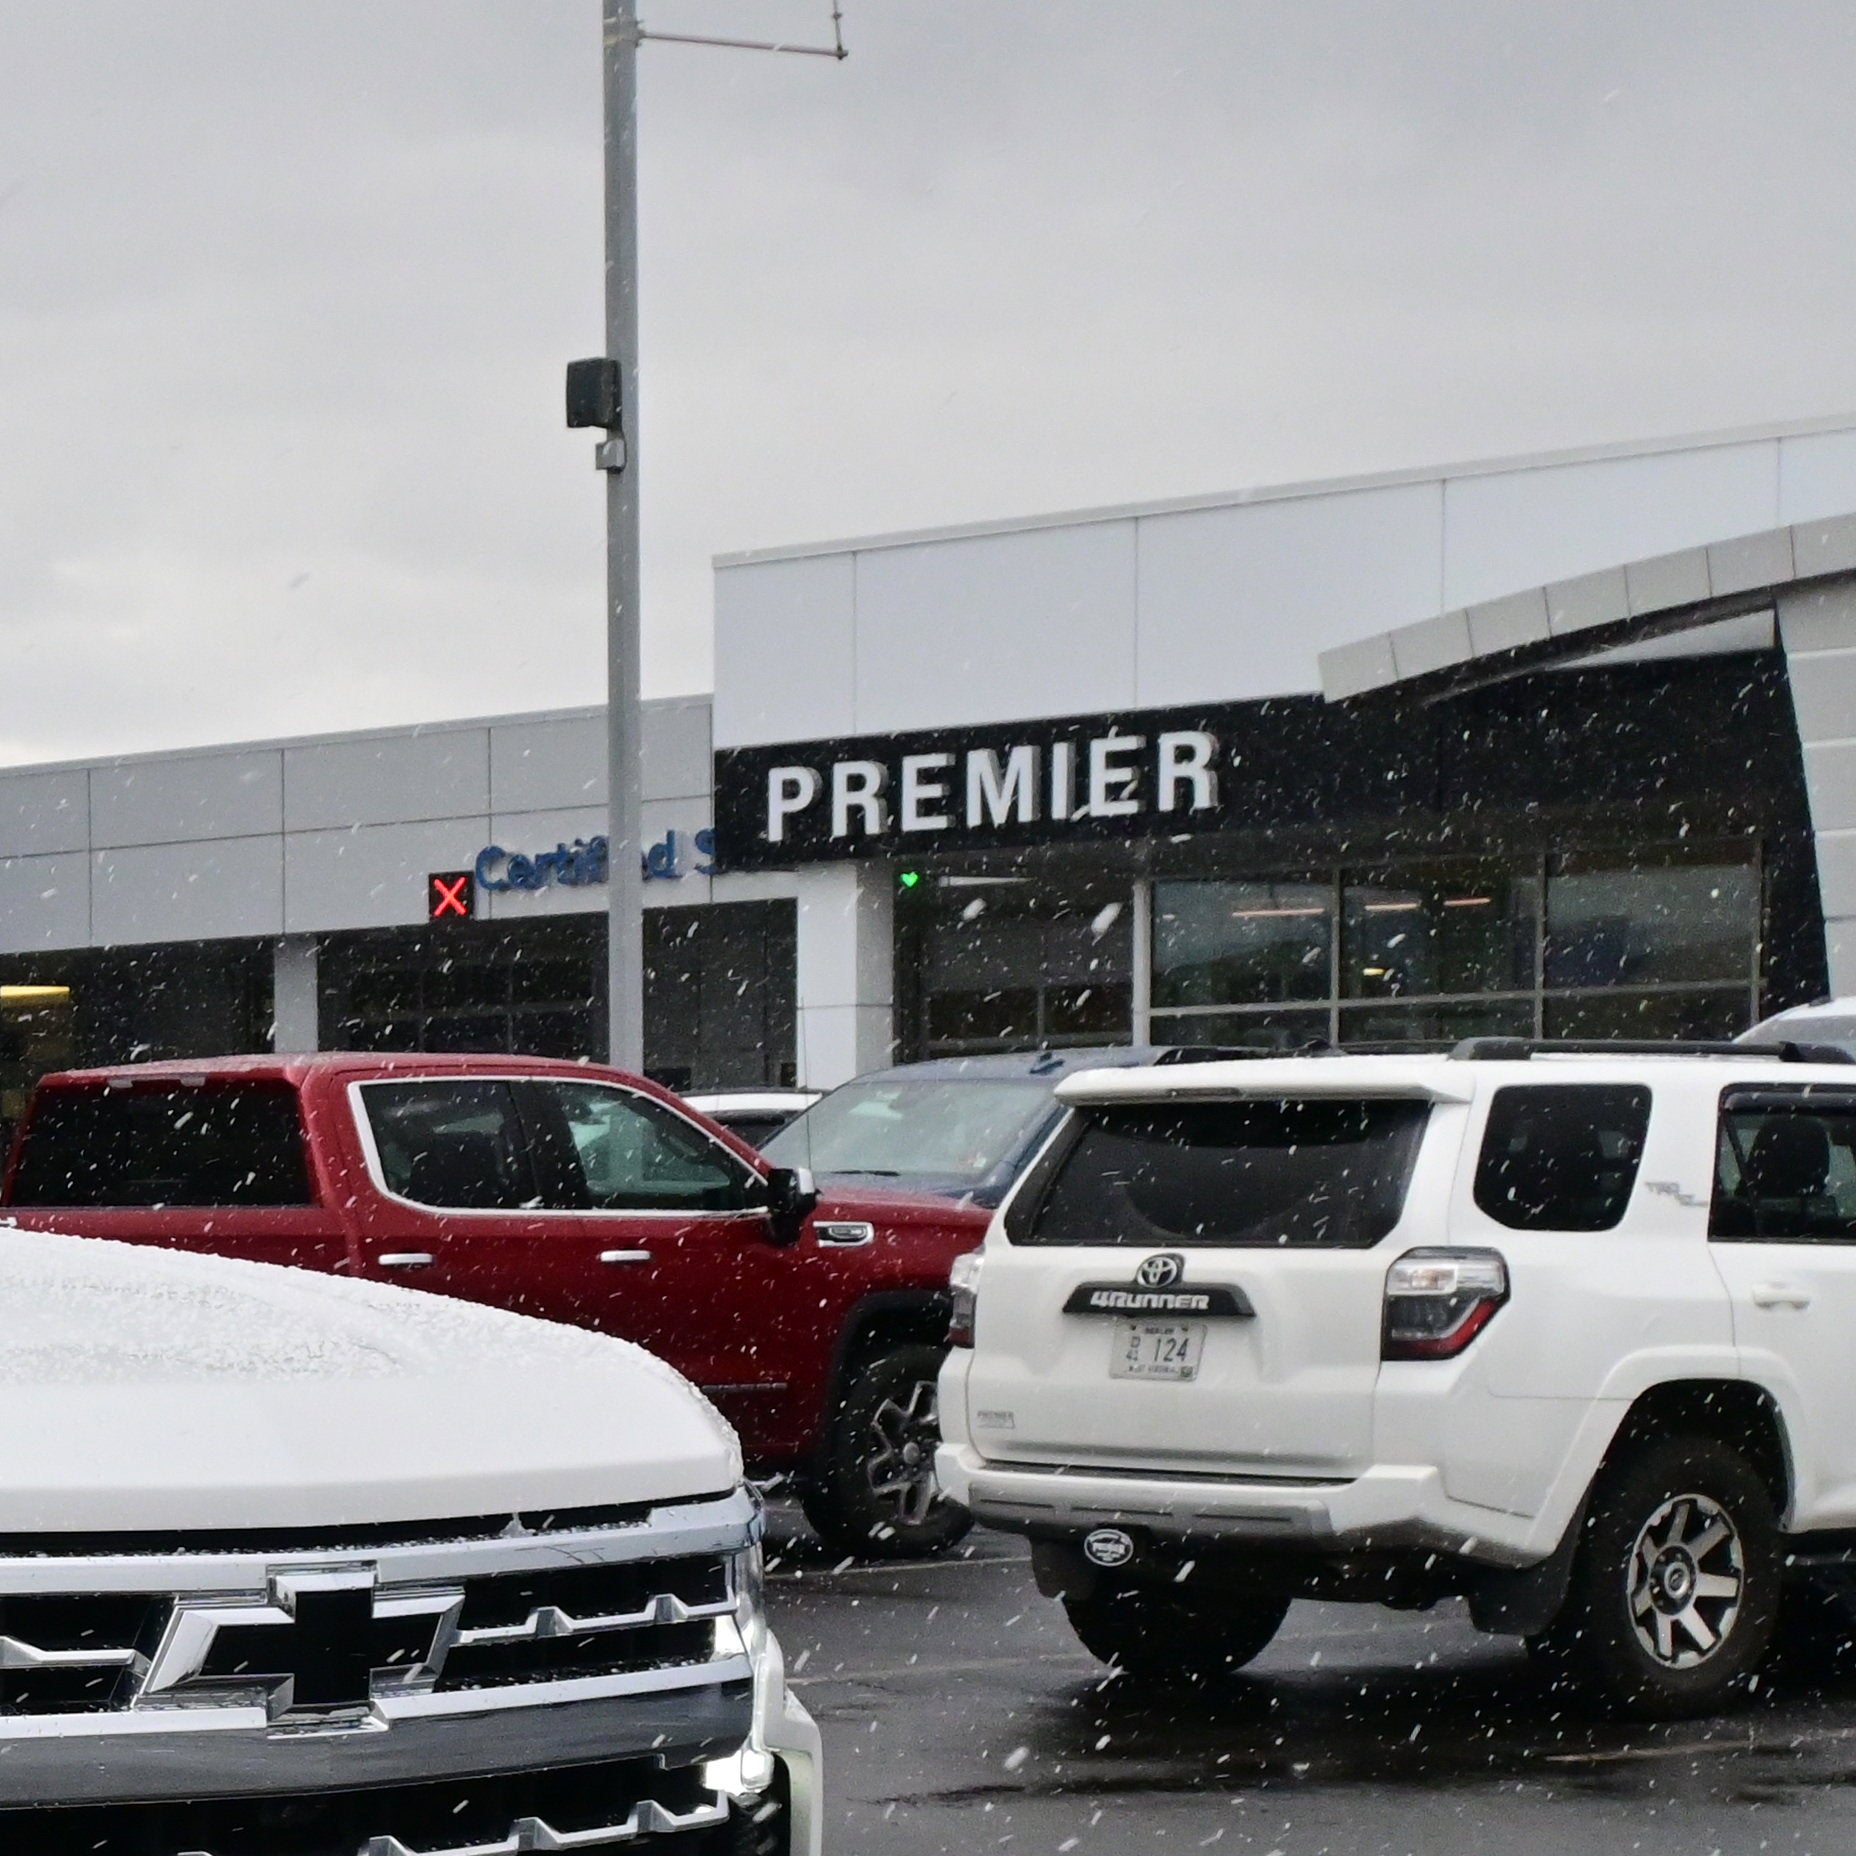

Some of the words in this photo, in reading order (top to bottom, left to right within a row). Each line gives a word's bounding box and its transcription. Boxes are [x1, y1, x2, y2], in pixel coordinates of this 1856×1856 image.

[767, 729, 1221, 843] PREMIER
[475, 829, 682, 891] Certifd
[1090, 1290, 1210, 1311] 4RUNNER
[1153, 1337, 1189, 1362] 124
